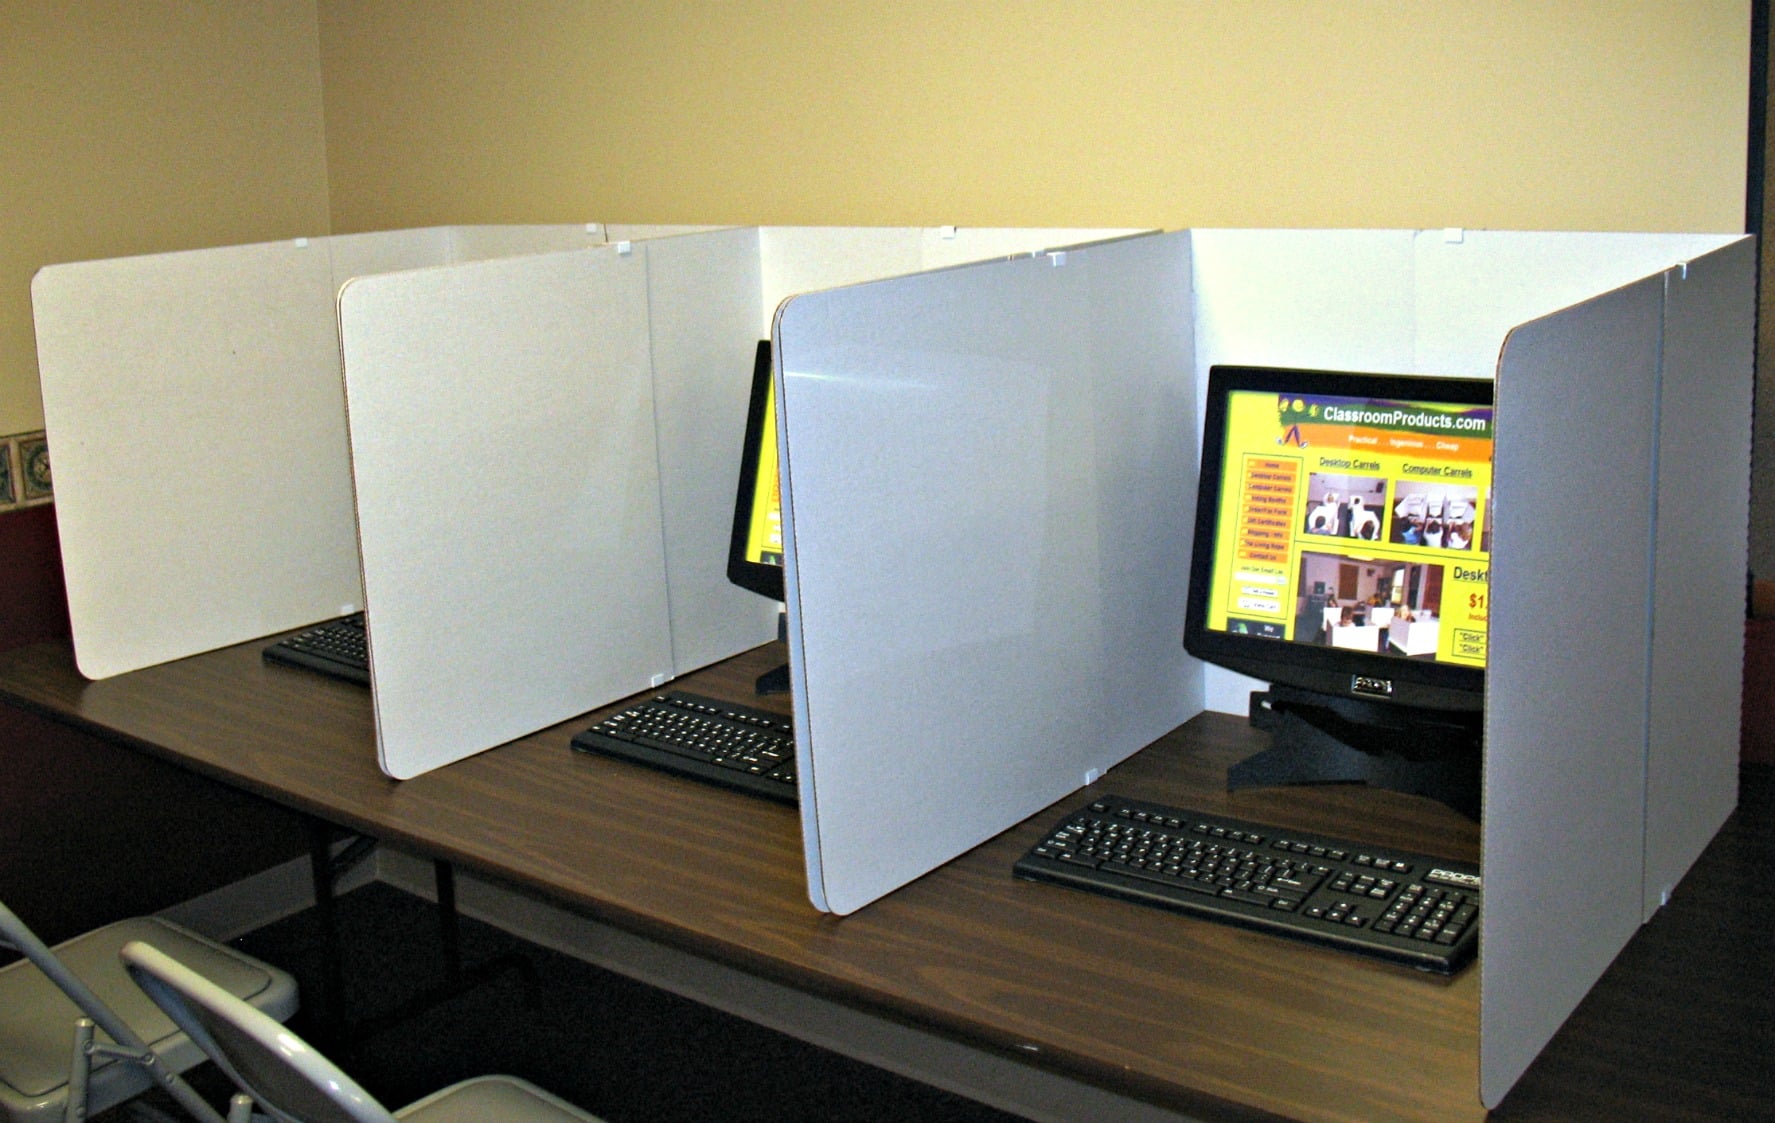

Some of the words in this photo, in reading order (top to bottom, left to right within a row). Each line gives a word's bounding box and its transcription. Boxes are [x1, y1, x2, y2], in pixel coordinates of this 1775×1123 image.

[1323, 406, 1486, 431] ClassroomProducts.com
[1320, 457, 1350, 469] Desktop
[1353, 459, 1380, 471] Carrels
[1402, 463, 1442, 476] Computer
[1444, 466, 1473, 478] Carrels
